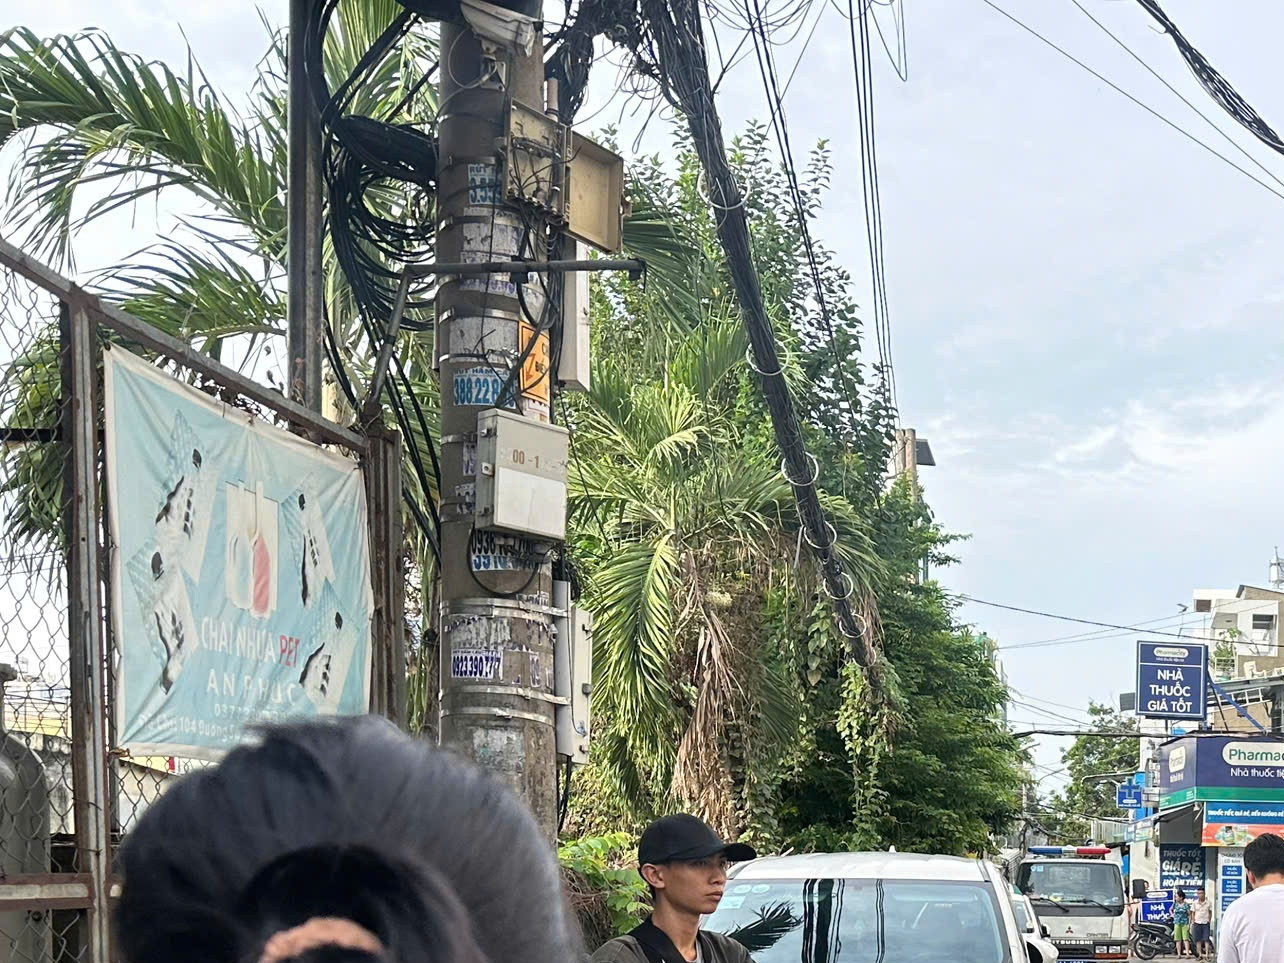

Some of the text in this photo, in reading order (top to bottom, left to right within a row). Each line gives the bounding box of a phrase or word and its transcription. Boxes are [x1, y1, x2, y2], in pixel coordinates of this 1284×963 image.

[278, 634, 301, 668] PET
[1157, 667, 1184, 681] NHÀ
[207, 668, 236, 697] AN
[1149, 681, 1192, 697] THUỐC
[1147, 697, 1193, 713] GIÁ TỐT
[1230, 768, 1249, 778] Nhà
[1251, 767, 1275, 778] thuốc
[1150, 902, 1166, 912] NHÀ
